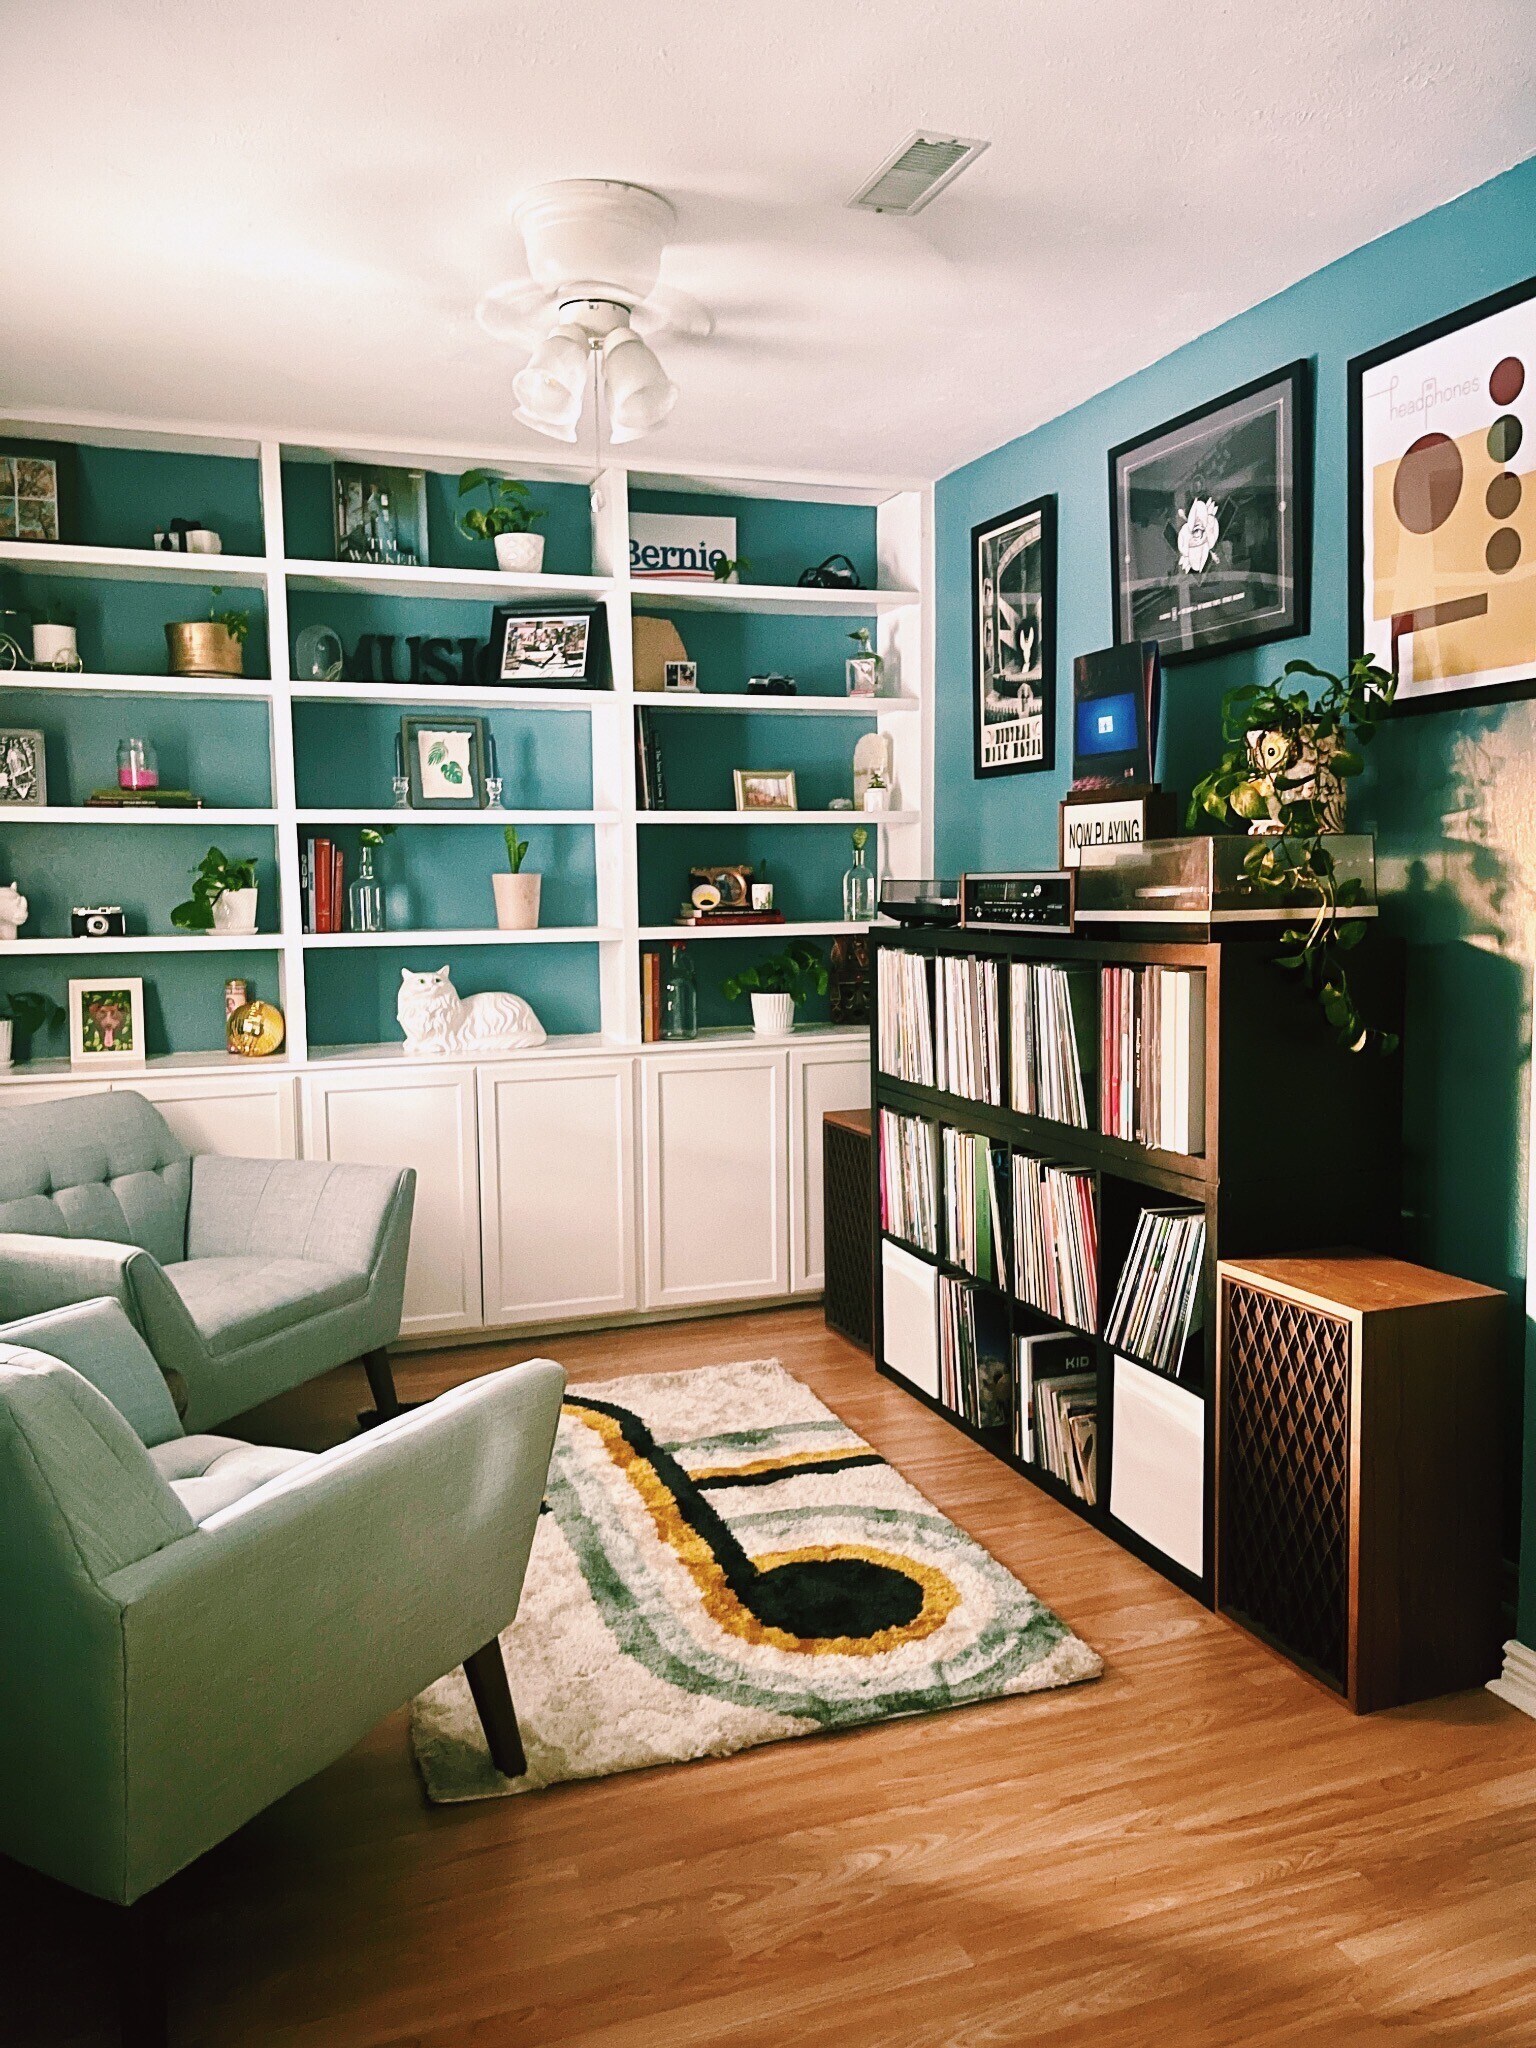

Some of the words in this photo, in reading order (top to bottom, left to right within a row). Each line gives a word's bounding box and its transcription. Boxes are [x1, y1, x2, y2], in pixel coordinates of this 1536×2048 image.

[1369, 375, 1480, 430] headphones
[367, 537, 397, 552] TIM
[629, 538, 727, 570] Bernie
[349, 549, 418, 566] WALKER
[1069, 822, 1093, 850] NOW
[1095, 818, 1140, 845] PLAYING
[1065, 1355, 1090, 1370] KID
